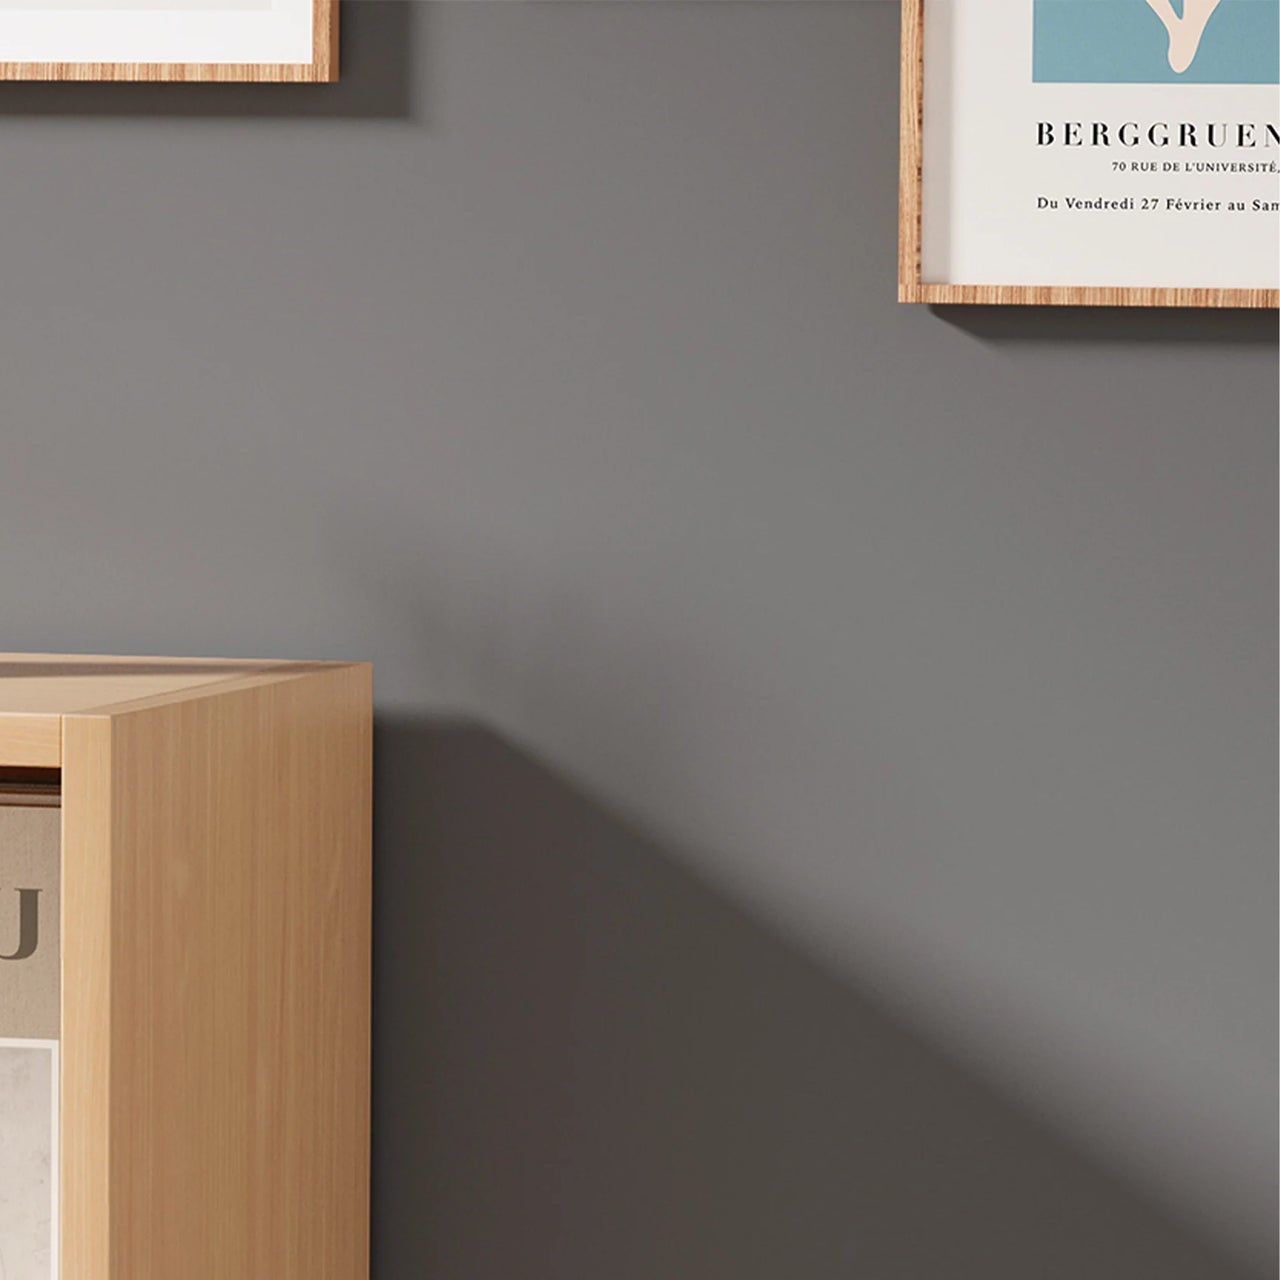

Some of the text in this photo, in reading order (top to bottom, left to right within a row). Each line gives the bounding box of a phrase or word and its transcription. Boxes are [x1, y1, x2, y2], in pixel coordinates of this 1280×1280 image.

[1036, 121, 1280, 148] BERGGRUEN
[1111, 161, 1127, 172] 70
[1130, 161, 1158, 172] RUE
[1162, 162, 1180, 173] DE
[1037, 196, 1059, 210] Du
[1065, 196, 1135, 211] Vendredi
[1141, 197, 1159, 211] 27
[1166, 197, 1222, 212] Février
[1227, 201, 1245, 211] au
